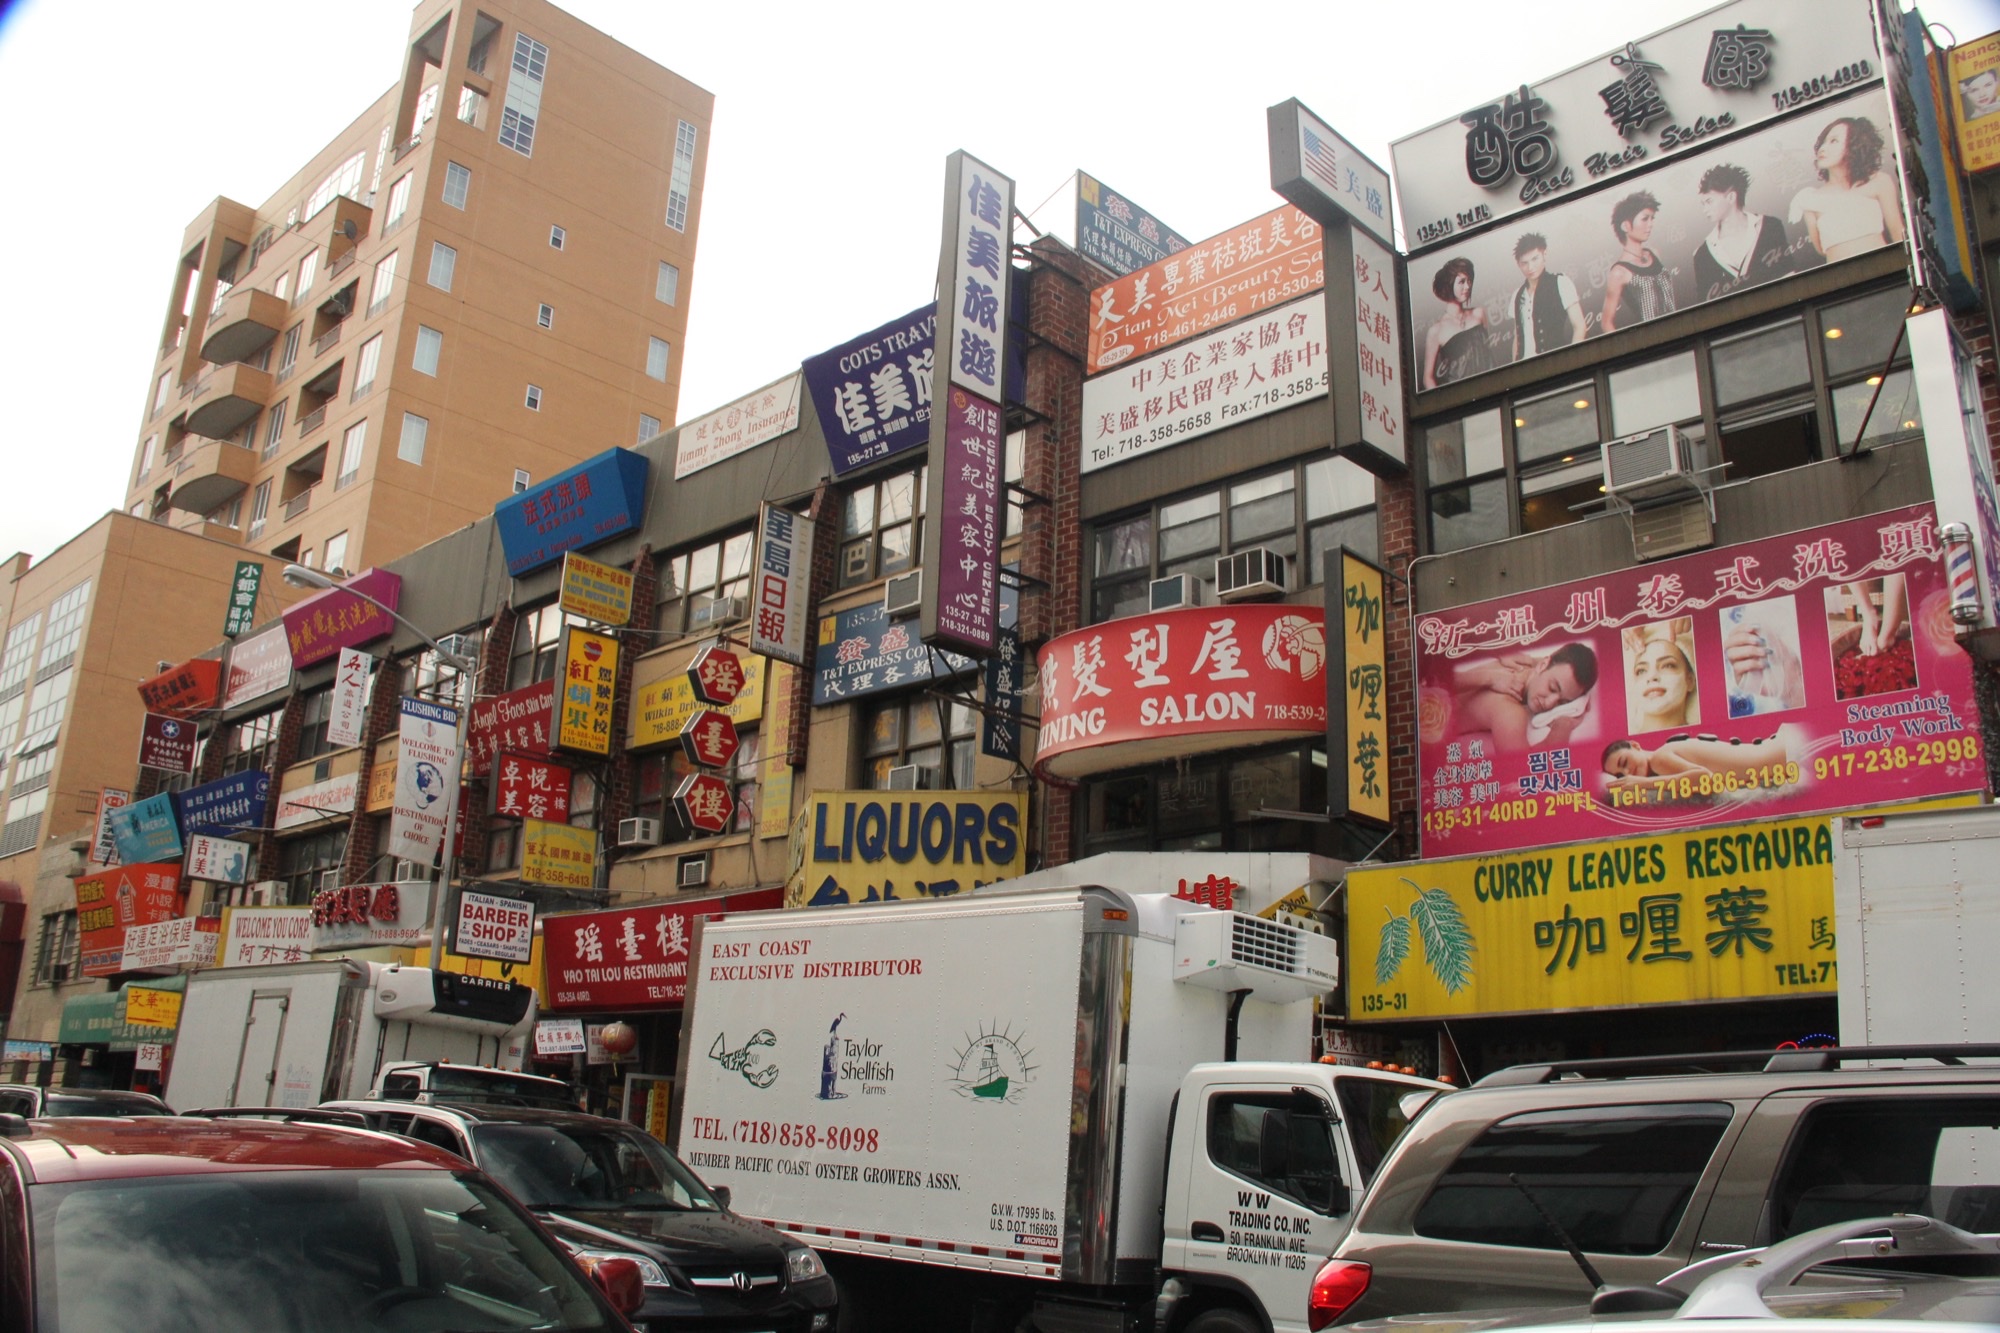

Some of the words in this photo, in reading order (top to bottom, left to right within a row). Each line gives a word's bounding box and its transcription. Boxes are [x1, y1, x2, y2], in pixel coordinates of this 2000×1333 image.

[1772, 60, 1871, 109] 718-961-4888
[1518, 165, 1574, 204] Cool
[1584, 142, 1647, 177] Hair
[1659, 109, 1735, 149] Salon
[1344, 166, 1385, 221] 美盛
[1093, 211, 1112, 235] T&T
[1113, 223, 1153, 261] EXPRESS
[1416, 217, 1453, 244] 135-31
[960, 174, 1002, 387] 佳美旅遊
[1101, 317, 1151, 350] Tian
[1157, 299, 1197, 326] Mei
[1204, 263, 1283, 308] Beauty
[1144, 303, 1237, 350] 718-461-2446
[1354, 253, 1378, 423] 移民留學
[840, 342, 883, 374] COTS
[1131, 312, 1308, 394] 中美企業家協會
[679, 443, 709, 465] Jimmy
[713, 430, 743, 450] Zhong
[747, 405, 797, 435] Insurance
[986, 409, 998, 436] NEW
[1091, 446, 1115, 463] Tel:
[1118, 411, 1212, 455] 718-358-5658
[984, 439, 997, 500] CENTURY
[522, 472, 593, 526] 法式洗頭
[955, 404, 985, 609] 創世紀美容中心
[983, 504, 995, 557] BEAUTY
[235, 565, 259, 606] 小都會
[757, 505, 793, 645] 星島日報
[981, 561, 992, 616] CENTER
[941, 616, 991, 642] 718-321-0889
[945, 605, 970, 622] 135-27
[973, 612, 988, 628] 3FL
[836, 625, 909, 665] 發盛
[341, 653, 362, 688] 名人
[822, 665, 845, 681] T&T
[848, 652, 901, 675] EXPRESS
[402, 699, 442, 721] FLUSHING
[442, 710, 458, 723] BID
[592, 665, 613, 736] 駕駛學校
[644, 707, 674, 722] Wilkin
[1140, 691, 1256, 726] SALON
[1847, 694, 1951, 724] Steaming
[469, 704, 498, 733] Angel
[497, 698, 526, 723] Face
[526, 697, 540, 715] Skin
[1840, 724, 1895, 748] Body
[1900, 713, 1964, 738] Work
[402, 737, 442, 755] WELCOME
[444, 748, 456, 758] TO
[408, 749, 448, 766] FLUSHING
[1528, 748, 1571, 774] 찜질
[502, 760, 551, 793] 卓悅
[1433, 759, 1493, 789] 全身按摩
[1519, 769, 1583, 797] 맛사지
[1609, 782, 1648, 808] Tel:
[1653, 761, 1799, 801] 718-886-3189
[1813, 736, 1978, 780] 917-238-2998
[500, 790, 548, 819] 美容
[1433, 787, 1464, 809] 美容
[1470, 781, 1501, 803] 美甲
[394, 805, 445, 828] DESTINATION
[414, 822, 425, 833] OF
[1423, 806, 1482, 832] 135-31
[1489, 798, 1539, 824] 40RD
[403, 830, 430, 846] CHOICE
[814, 801, 1018, 866] LIQUORS
[194, 838, 210, 875] 吉美
[144, 873, 176, 892] 漫畫
[525, 866, 590, 887] 718-358-6413
[1474, 857, 1554, 903] CURRY
[1567, 843, 1666, 893] LEAVES
[146, 893, 173, 908] 小說
[468, 894, 495, 906] ITALIAN
[499, 899, 528, 912] SPANISH
[235, 916, 272, 940] WELCOME
[272, 916, 288, 938] YOU
[288, 916, 311, 939] CORP.
[463, 903, 530, 929] BARBER
[126, 920, 193, 951] 好運足浴保健
[369, 928, 420, 940] 718-888-9609
[458, 937, 474, 946] FADES
[476, 941, 500, 949] CEASARS
[502, 944, 528, 954] SHAPE-UPS
[472, 922, 517, 943] SHOP
[494, 950, 516, 959] REGULAR
[711, 942, 751, 959] EAST
[759, 939, 812, 957] COAST
[461, 975, 512, 992] CARRIER
[564, 969, 584, 984] YAO
[585, 968, 601, 983] TAI
[602, 965, 622, 982] LOU
[624, 961, 688, 981] RESTAURANT
[709, 962, 795, 982] EXCLUSIVE
[803, 958, 923, 979] DISTRIBUTOR
[128, 990, 160, 1009] 文華
[1362, 993, 1408, 1013] 135-31
[844, 1038, 884, 1064] Taylor
[840, 1061, 895, 1081] Shellfish
[861, 1083, 887, 1095] Farms
[693, 1116, 729, 1142] TEL.
[732, 1119, 880, 1154] (718)858-8098
[688, 1151, 731, 1170] MEMBER
[734, 1156, 774, 1174] PACIFIC
[777, 1158, 812, 1177] COAST
[815, 1162, 859, 1182] OYSTER
[863, 1167, 922, 1188] GROWERS
[926, 1172, 961, 1192] ASSN.
[991, 1203, 1014, 1217] G.V.W.
[1017, 1206, 1040, 1220] 17995
[1042, 1208, 1056, 1221] lbs.
[1229, 1210, 1271, 1232] TRADING
[1273, 1214, 1291, 1235] CO.,
[1292, 1217, 1313, 1235] INC.
[990, 1218, 1005, 1231] U.S.
[1007, 1219, 1027, 1234] D.O.T.
[1029, 1223, 1058, 1237] 1166928
[1022, 1236, 1057, 1247] MORGAN
[1230, 1230, 1241, 1246] 50
[1244, 1233, 1287, 1251] FRANKLIN
[1288, 1238, 1308, 1253] AVE.
[1227, 1246, 1268, 1266] BROOKLYN
[1270, 1252, 1282, 1269] NY
[1284, 1254, 1307, 1271] 11205
